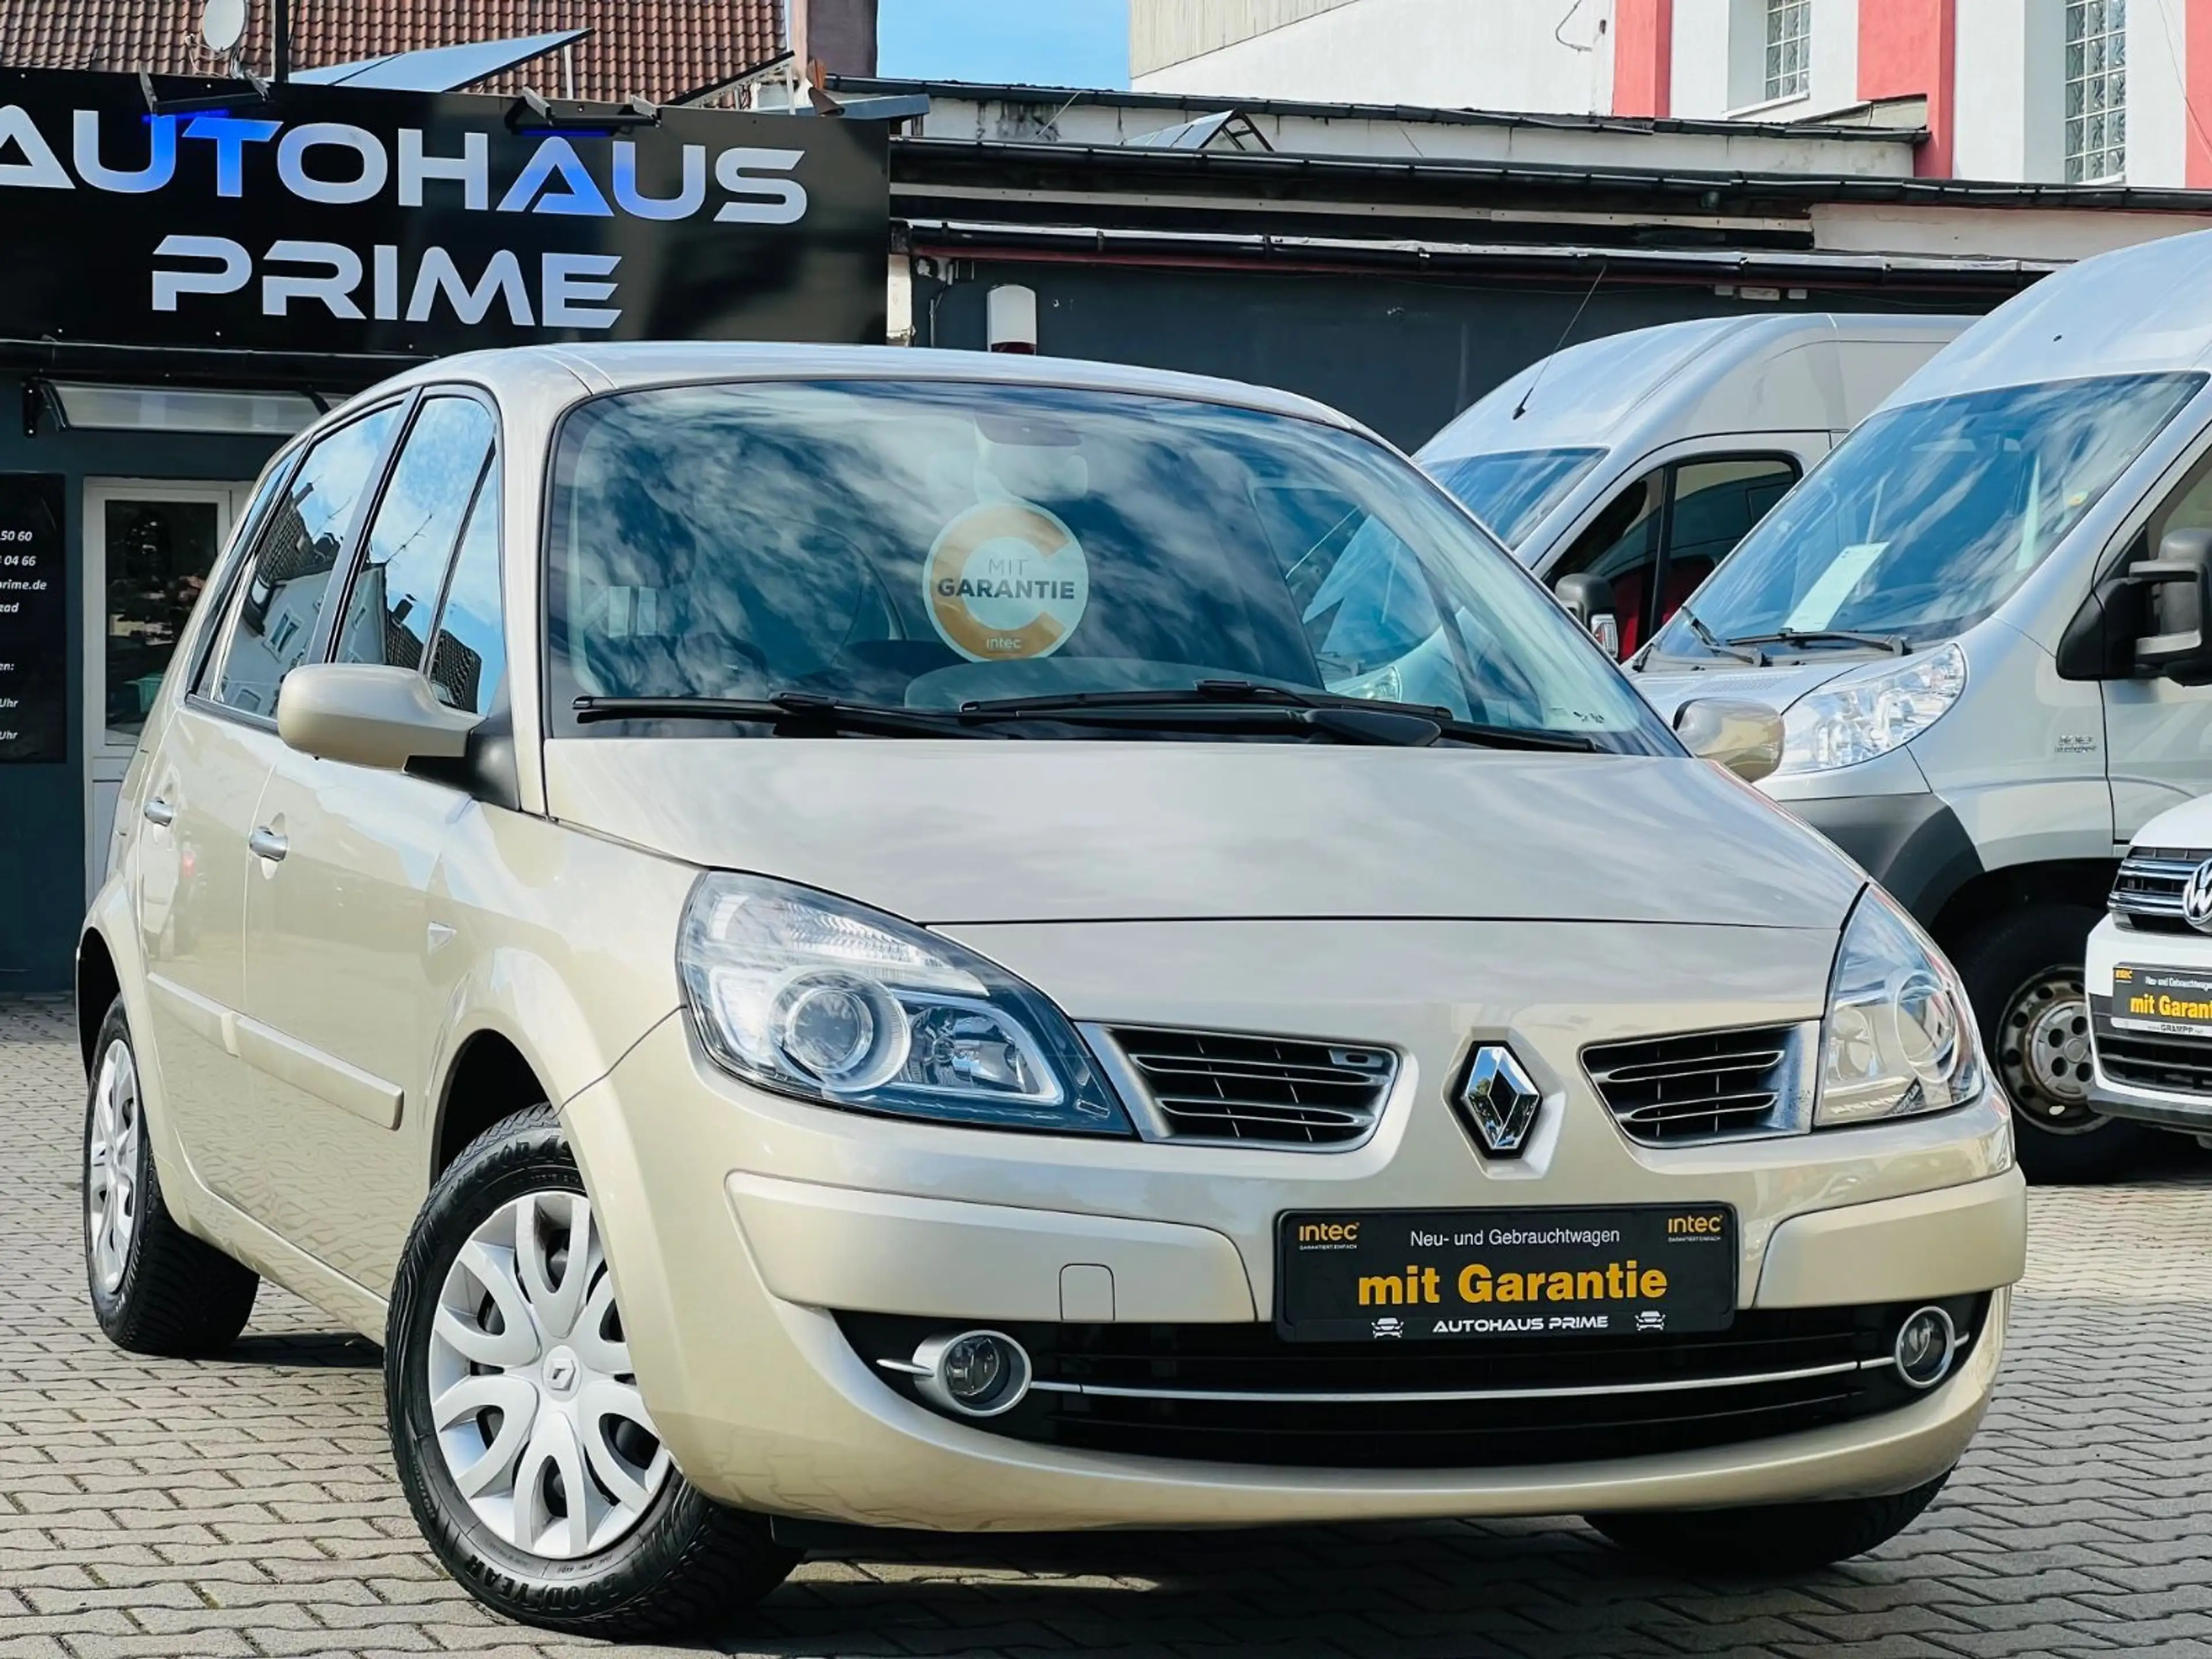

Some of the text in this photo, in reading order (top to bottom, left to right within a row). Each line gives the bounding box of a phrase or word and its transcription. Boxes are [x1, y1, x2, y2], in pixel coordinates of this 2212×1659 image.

[151, 234, 623, 329] PRIME
[17, 531, 33, 541] 60
[3, 555, 19, 566] 04
[21, 555, 36, 566] 66
[988, 558, 1029, 575] MIT
[937, 578, 1075, 600] GARANTIE
[986, 637, 1022, 650] intec
[2130, 993, 2155, 1014] mit
[1299, 1222, 1360, 1241] intec
[1668, 1215, 1723, 1233] intec
[1410, 1228, 1620, 1247] Neu- und Gebrauchtwagen
[1358, 1260, 1668, 1305] mit Garantie
[1432, 1315, 1609, 1333] AUTOHAUS PRIME
